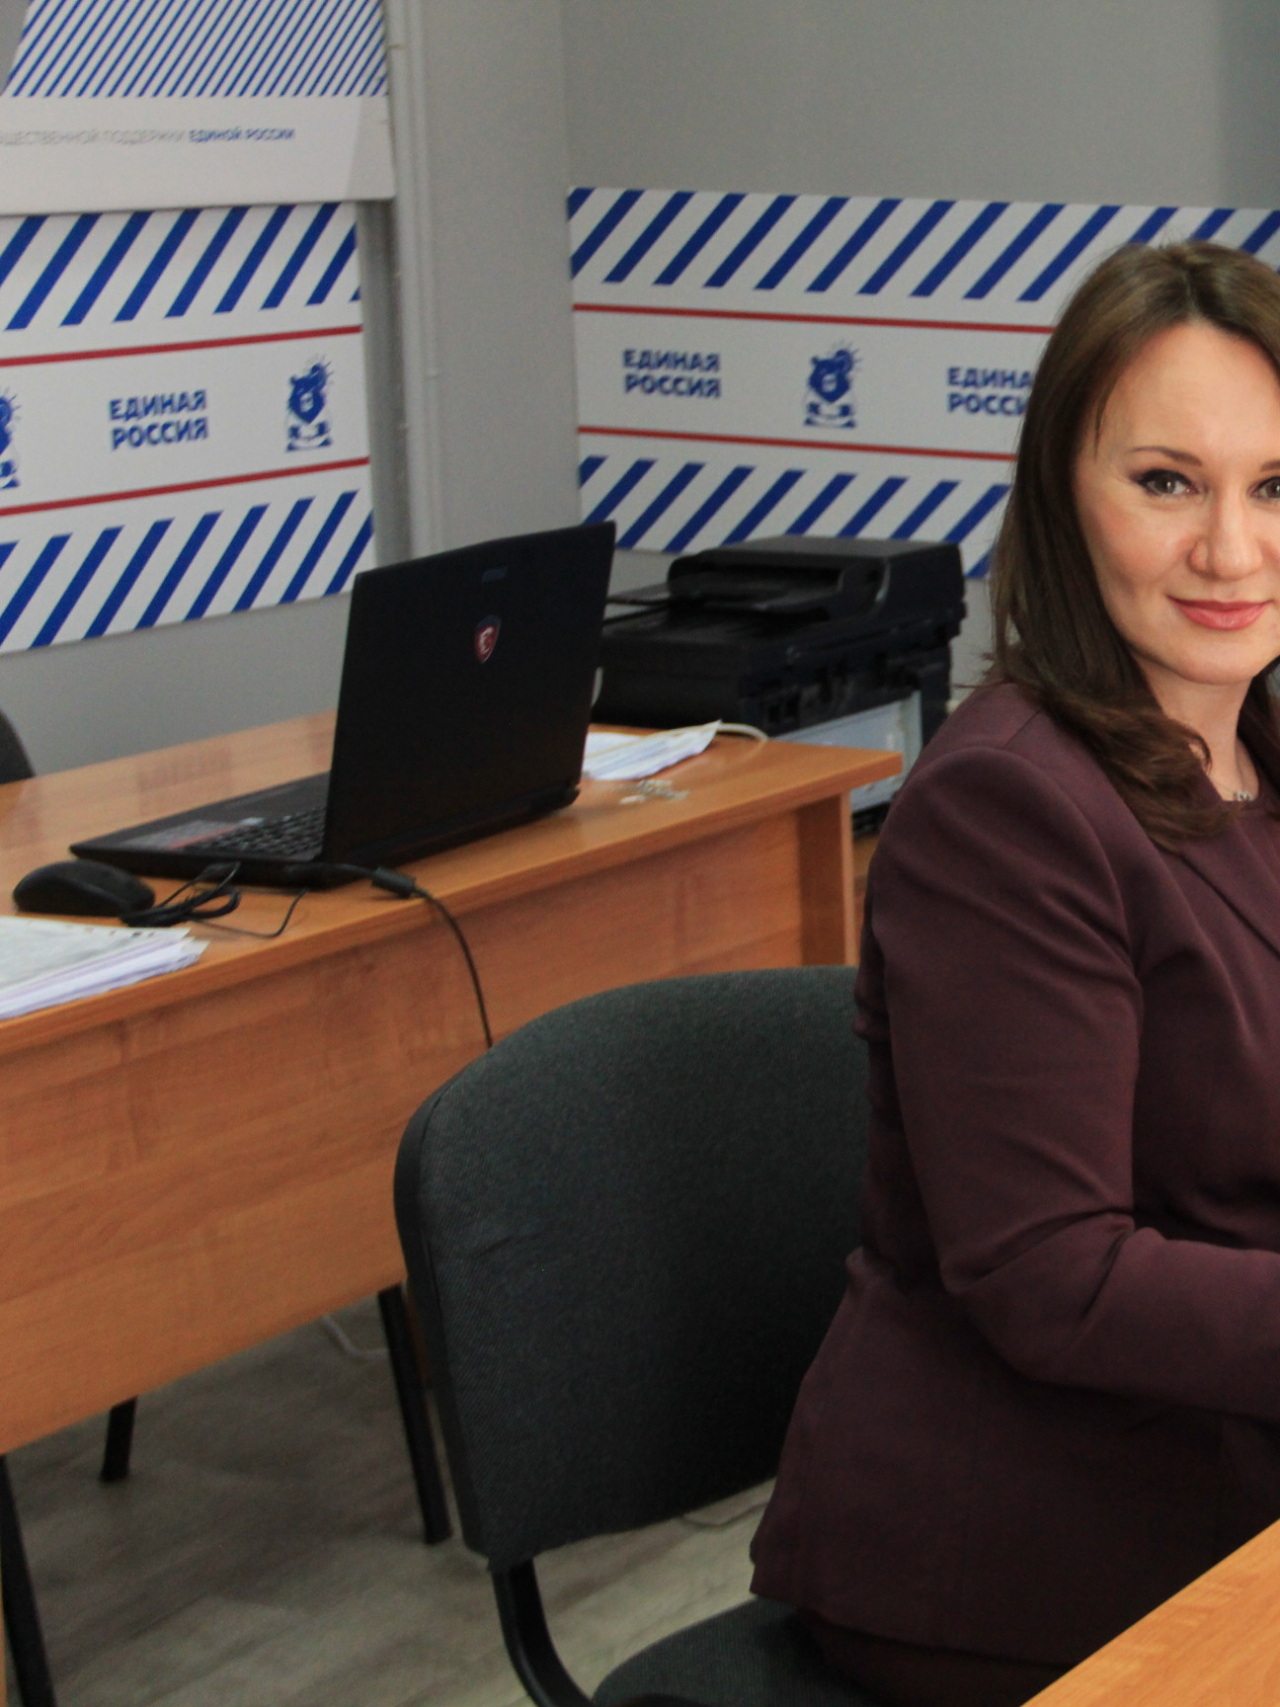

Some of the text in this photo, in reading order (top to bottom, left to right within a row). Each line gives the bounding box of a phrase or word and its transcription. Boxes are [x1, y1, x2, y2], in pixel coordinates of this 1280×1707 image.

[622, 348, 720, 373] ЕДИНАЯ
[624, 373, 721, 399] РОССИЯ
[947, 366, 1033, 389] ЕДИНА
[108, 388, 207, 422] ЕДИНАЯ
[112, 416, 209, 451] РОССИЯ
